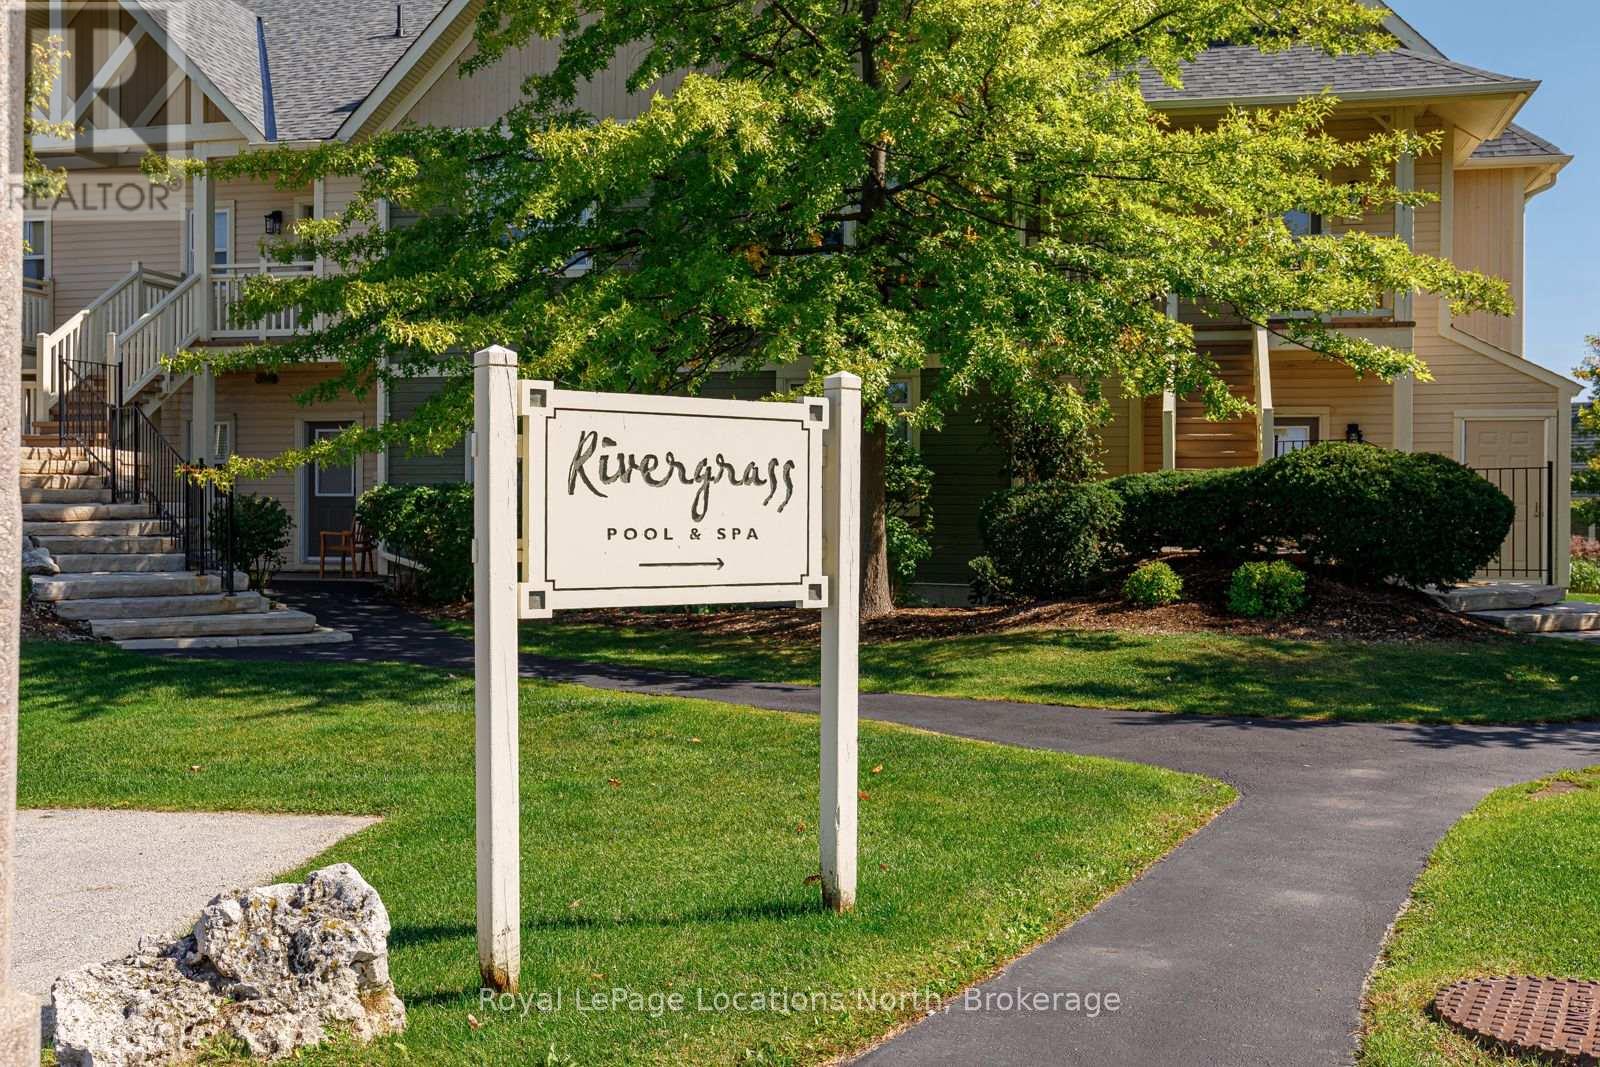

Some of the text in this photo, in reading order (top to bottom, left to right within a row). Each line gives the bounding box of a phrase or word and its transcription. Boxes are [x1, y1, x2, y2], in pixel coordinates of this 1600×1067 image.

[567, 430, 796, 523] Rivergrass
[606, 527, 760, 541] POOL & SPA
